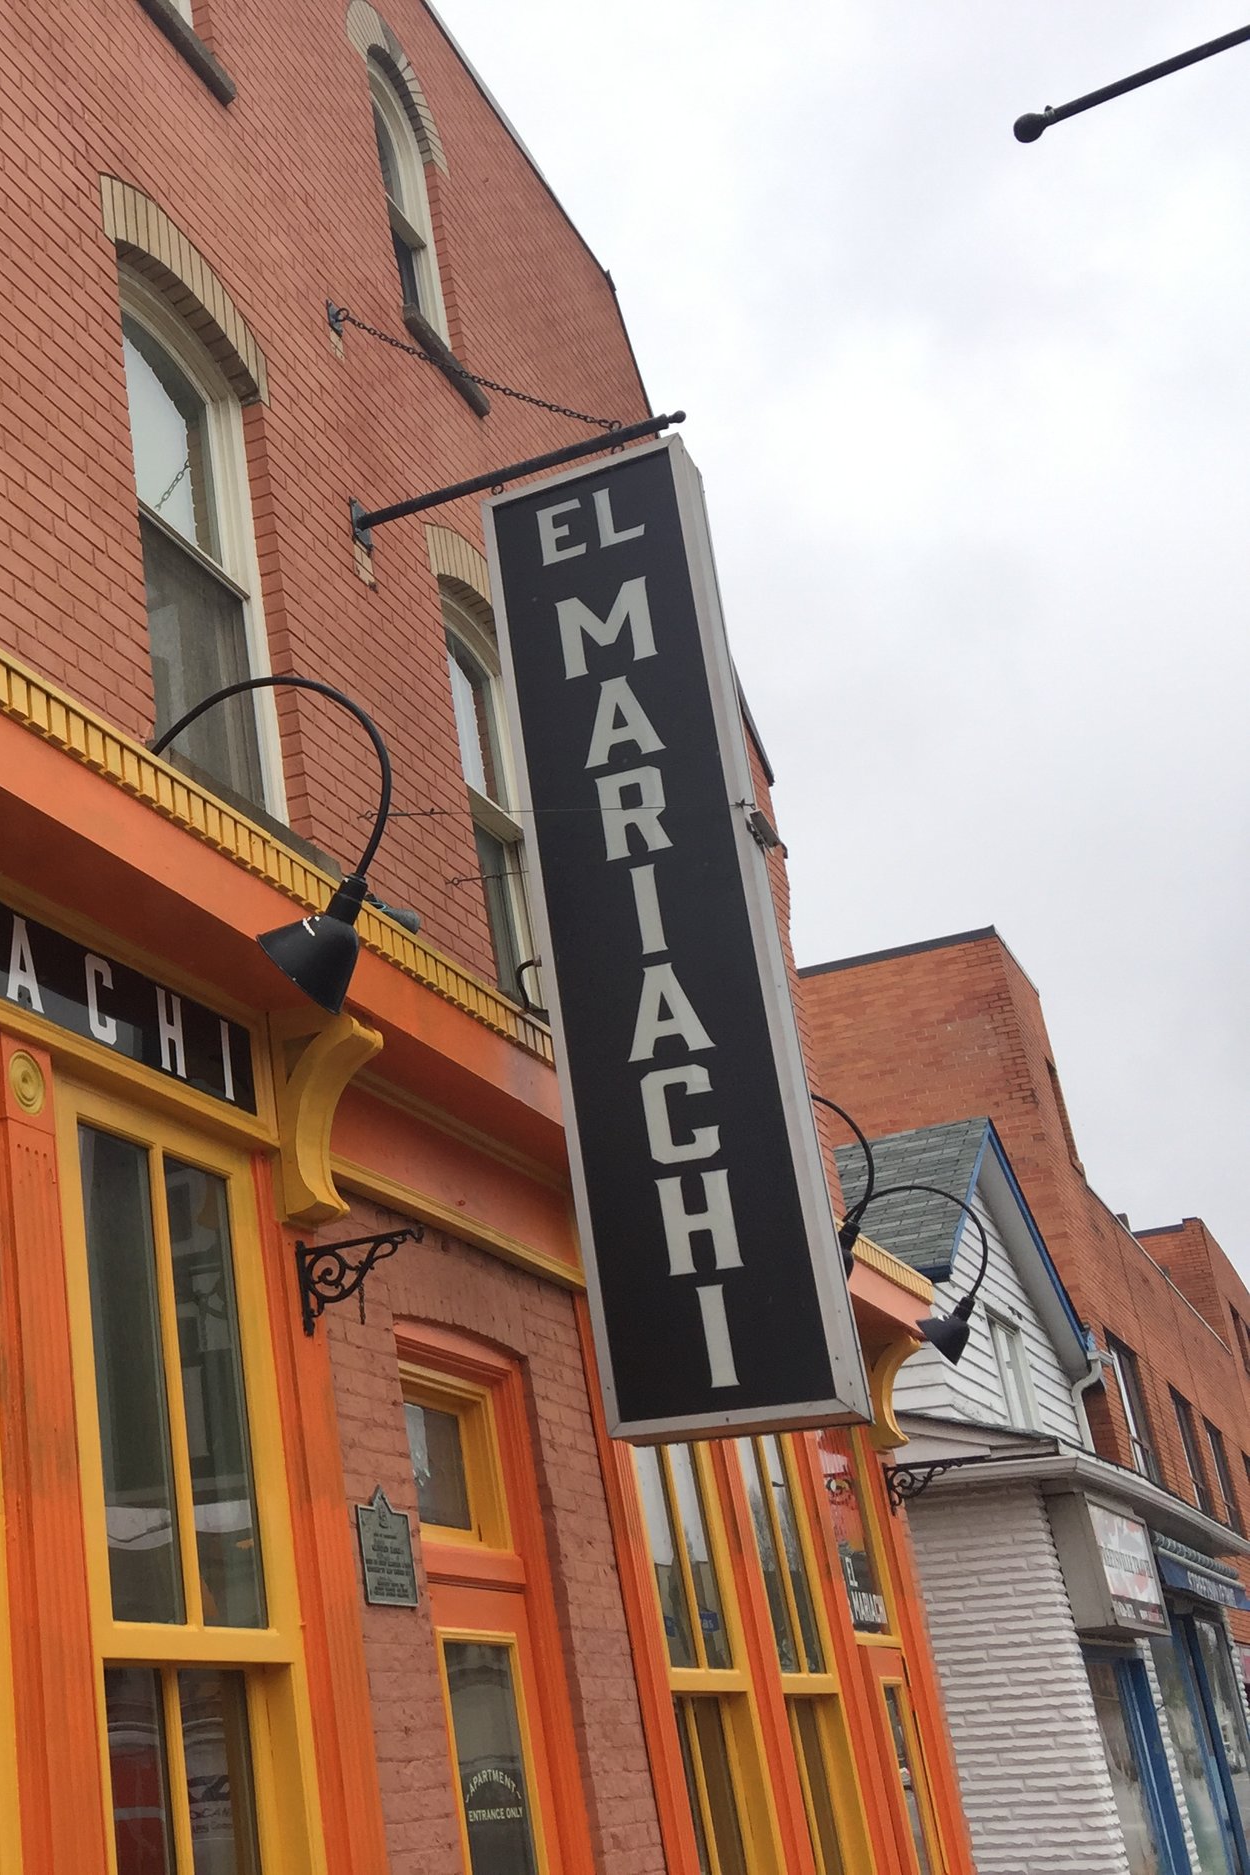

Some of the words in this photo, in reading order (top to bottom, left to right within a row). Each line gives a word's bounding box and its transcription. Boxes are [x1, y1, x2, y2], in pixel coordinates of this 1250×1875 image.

[535, 488, 646, 567] EL
[554, 576, 745, 1389] MARIACHI
[468, 1769, 517, 1797] APARTMENT
[468, 1807, 506, 1822] ENTRANCE
[505, 1806, 523, 1819] ONLY
